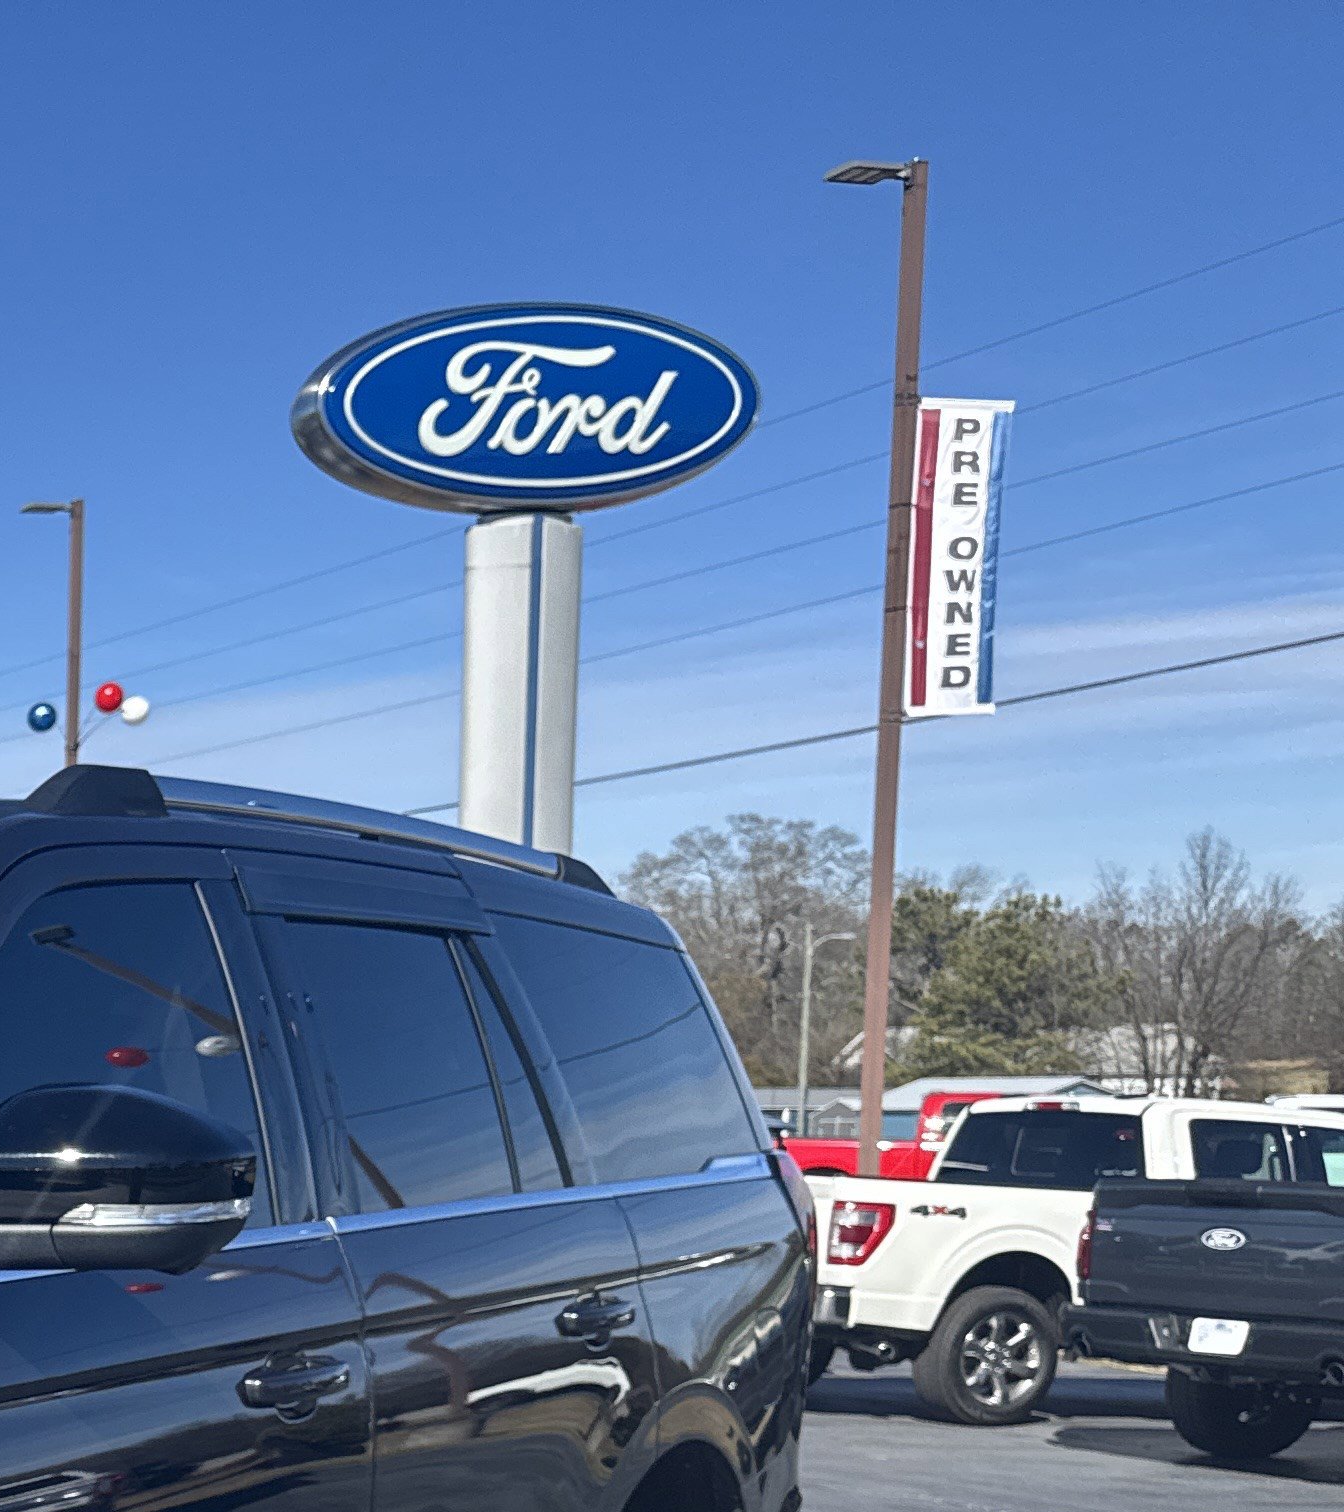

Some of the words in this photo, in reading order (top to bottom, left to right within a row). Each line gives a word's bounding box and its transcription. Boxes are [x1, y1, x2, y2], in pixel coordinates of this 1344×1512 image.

[418, 340, 679, 457] Ford
[951, 418, 980, 507] PRE
[939, 536, 978, 690] OWNED
